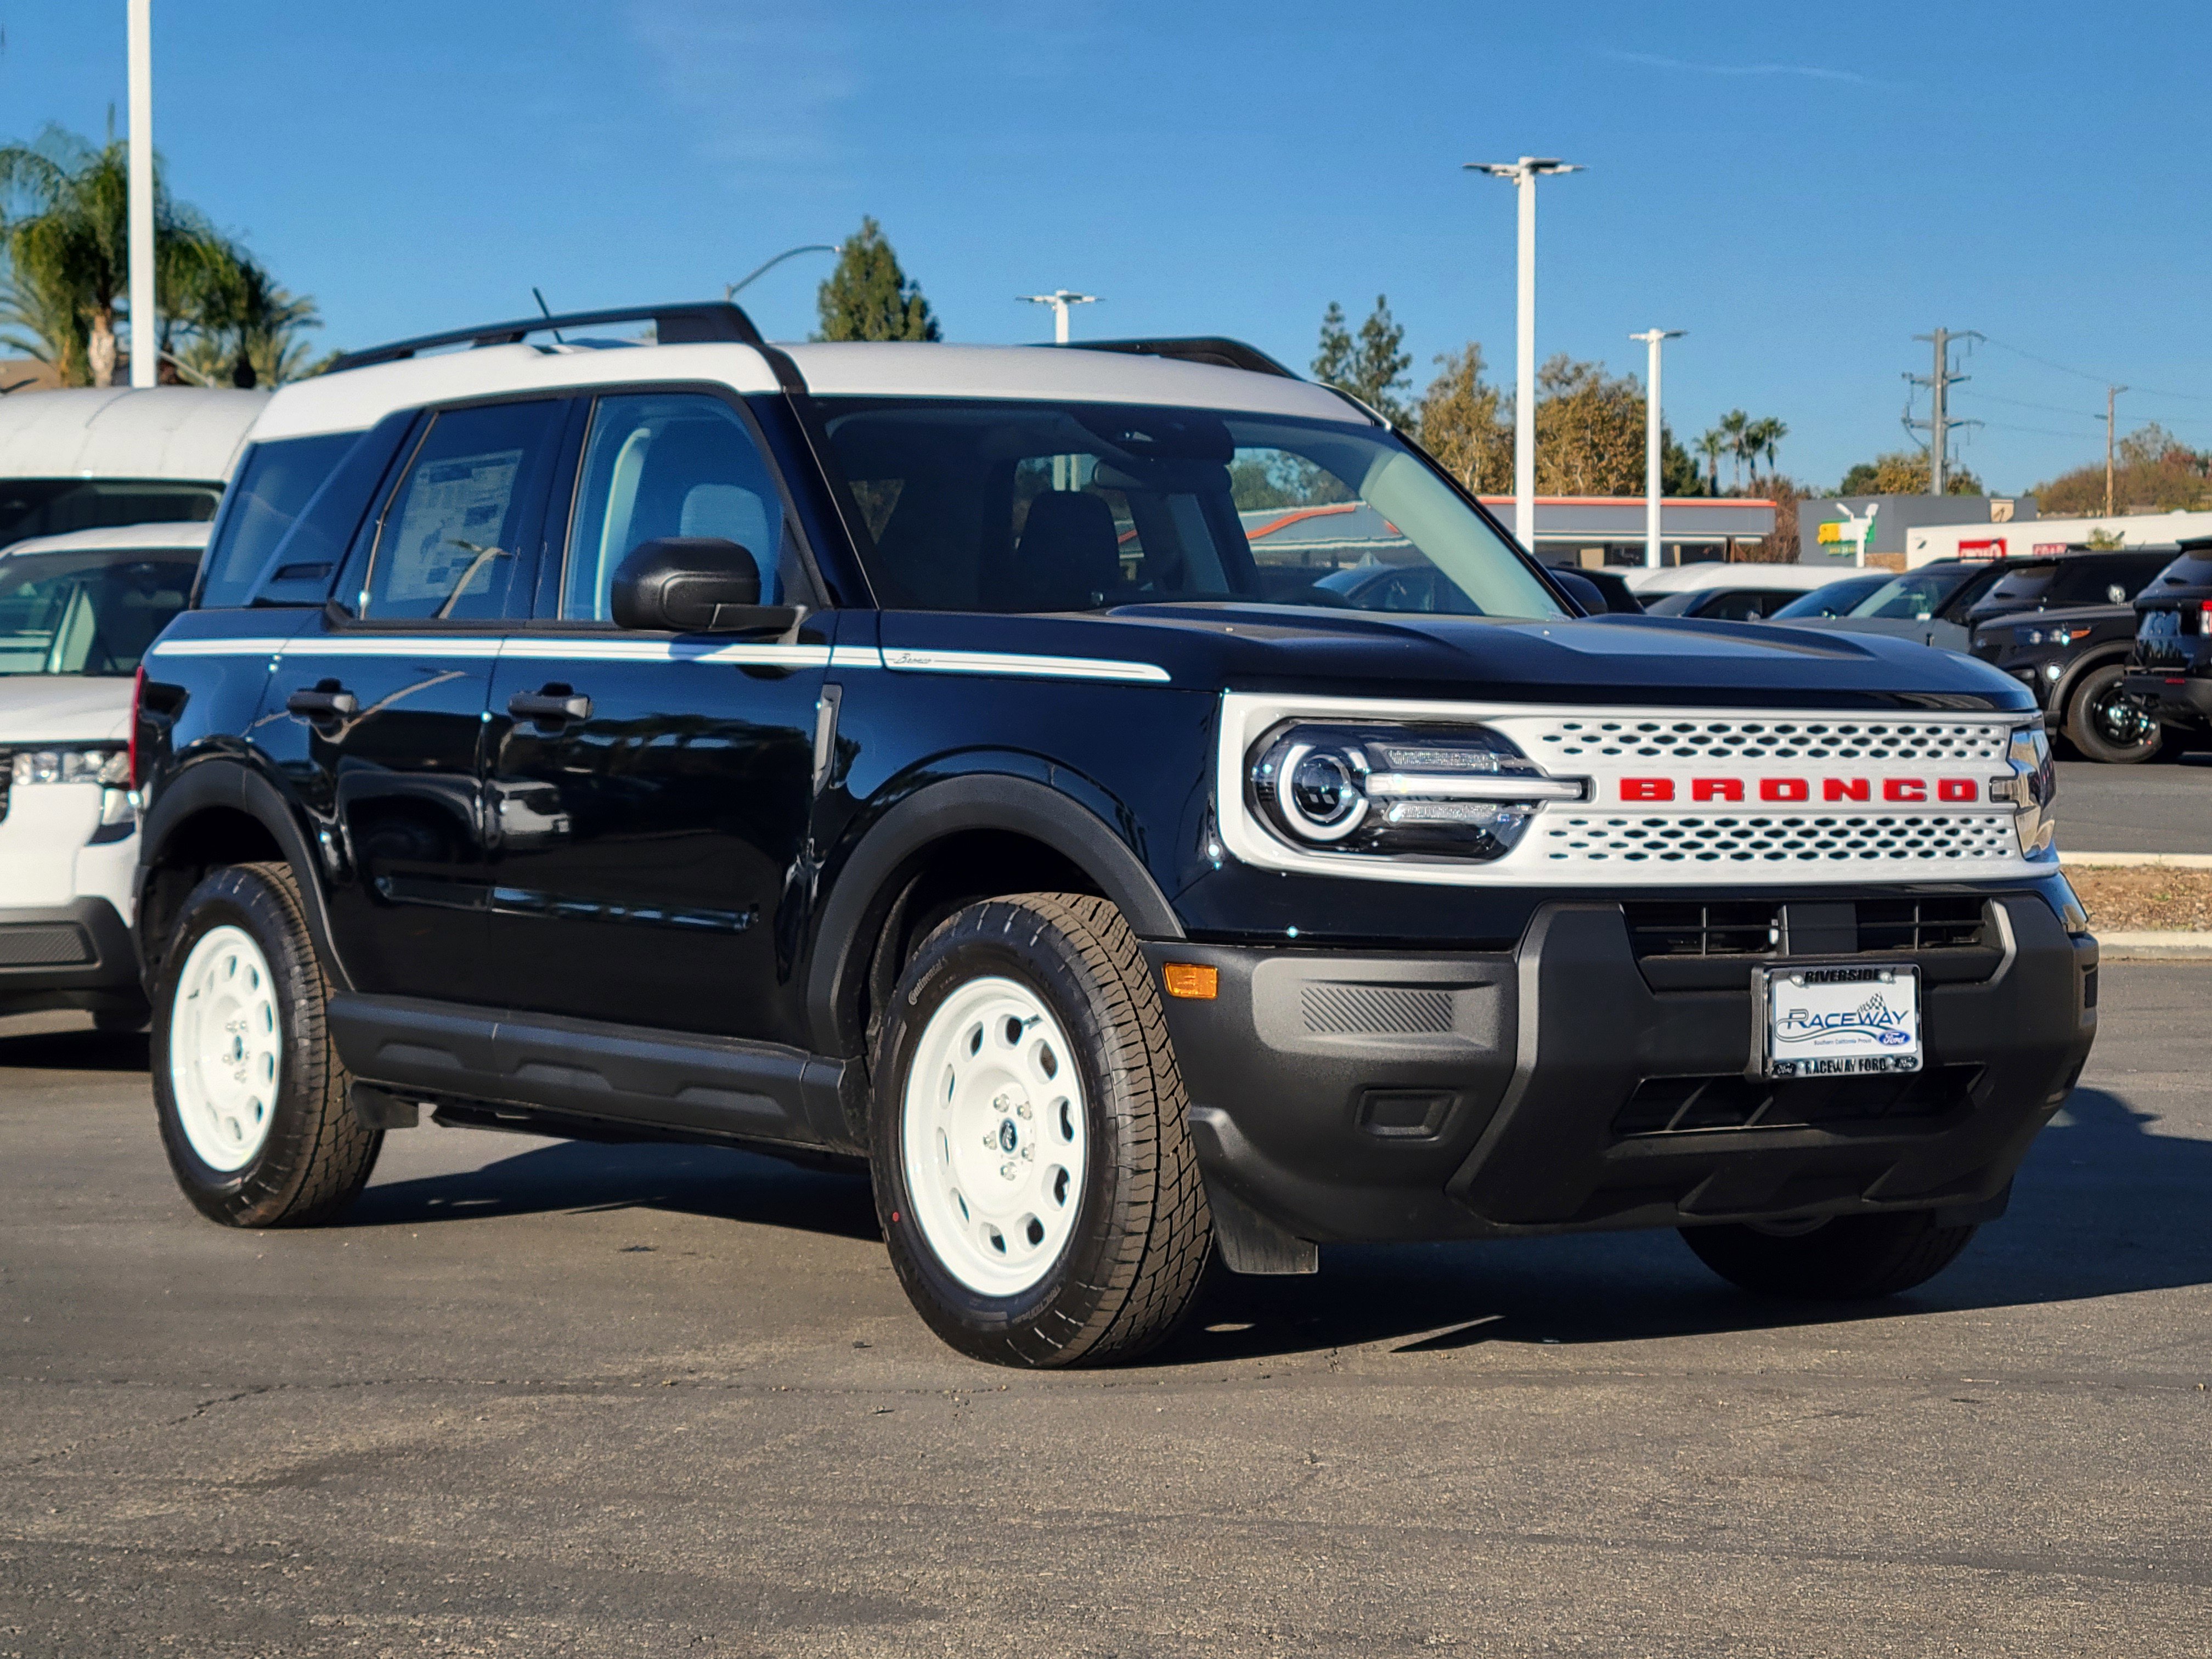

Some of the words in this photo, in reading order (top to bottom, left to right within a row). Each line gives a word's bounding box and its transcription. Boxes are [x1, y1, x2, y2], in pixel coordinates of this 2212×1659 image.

[1620, 777, 1978, 802] BRONCO
[1882, 1031, 1907, 1046] Ford
[1805, 1058, 1857, 1075] RACEWAY
[1859, 1057, 1886, 1071] FORD
